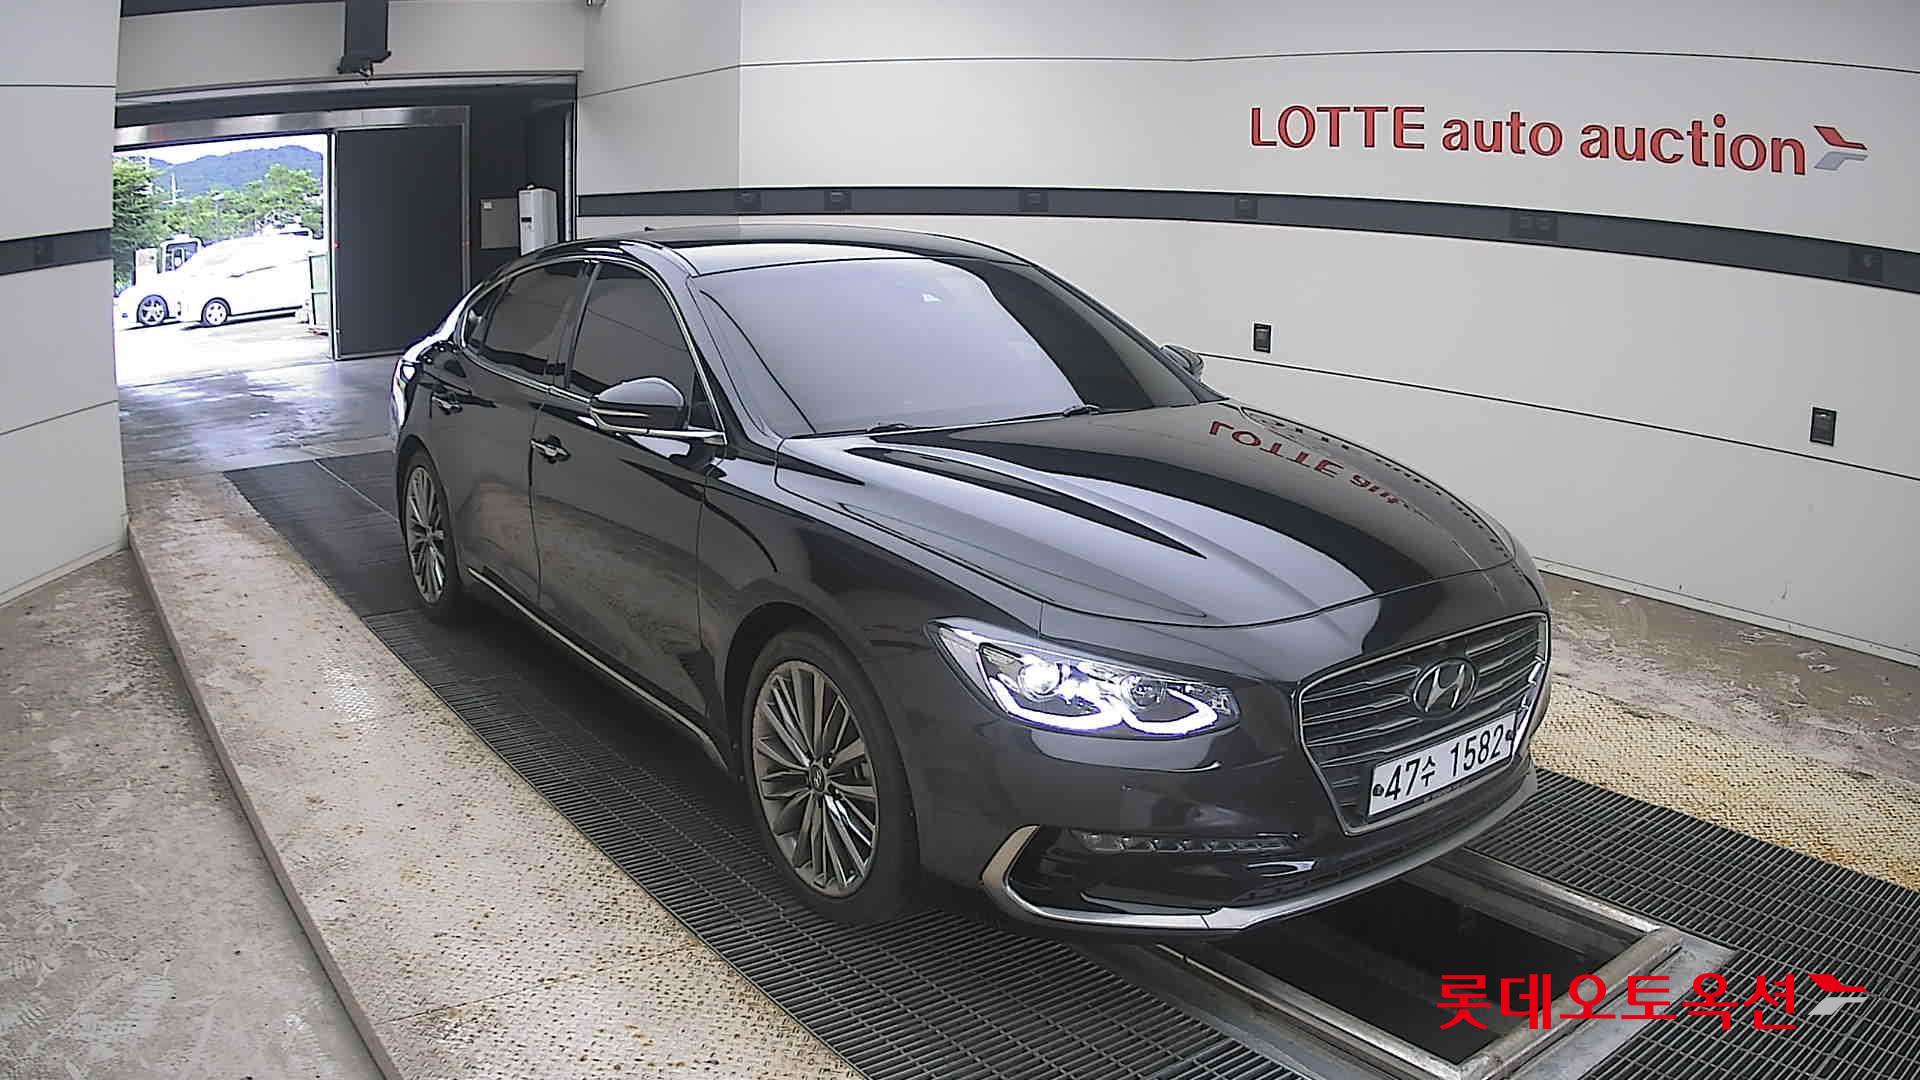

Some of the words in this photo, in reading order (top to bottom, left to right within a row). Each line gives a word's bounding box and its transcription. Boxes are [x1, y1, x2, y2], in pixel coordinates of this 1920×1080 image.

[1250, 105, 1426, 150] LOTTE
[1441, 111, 1563, 158] auto
[1580, 114, 1807, 175] auction
[1384, 756, 1436, 801] 47수
[1450, 724, 1504, 777] 1582
